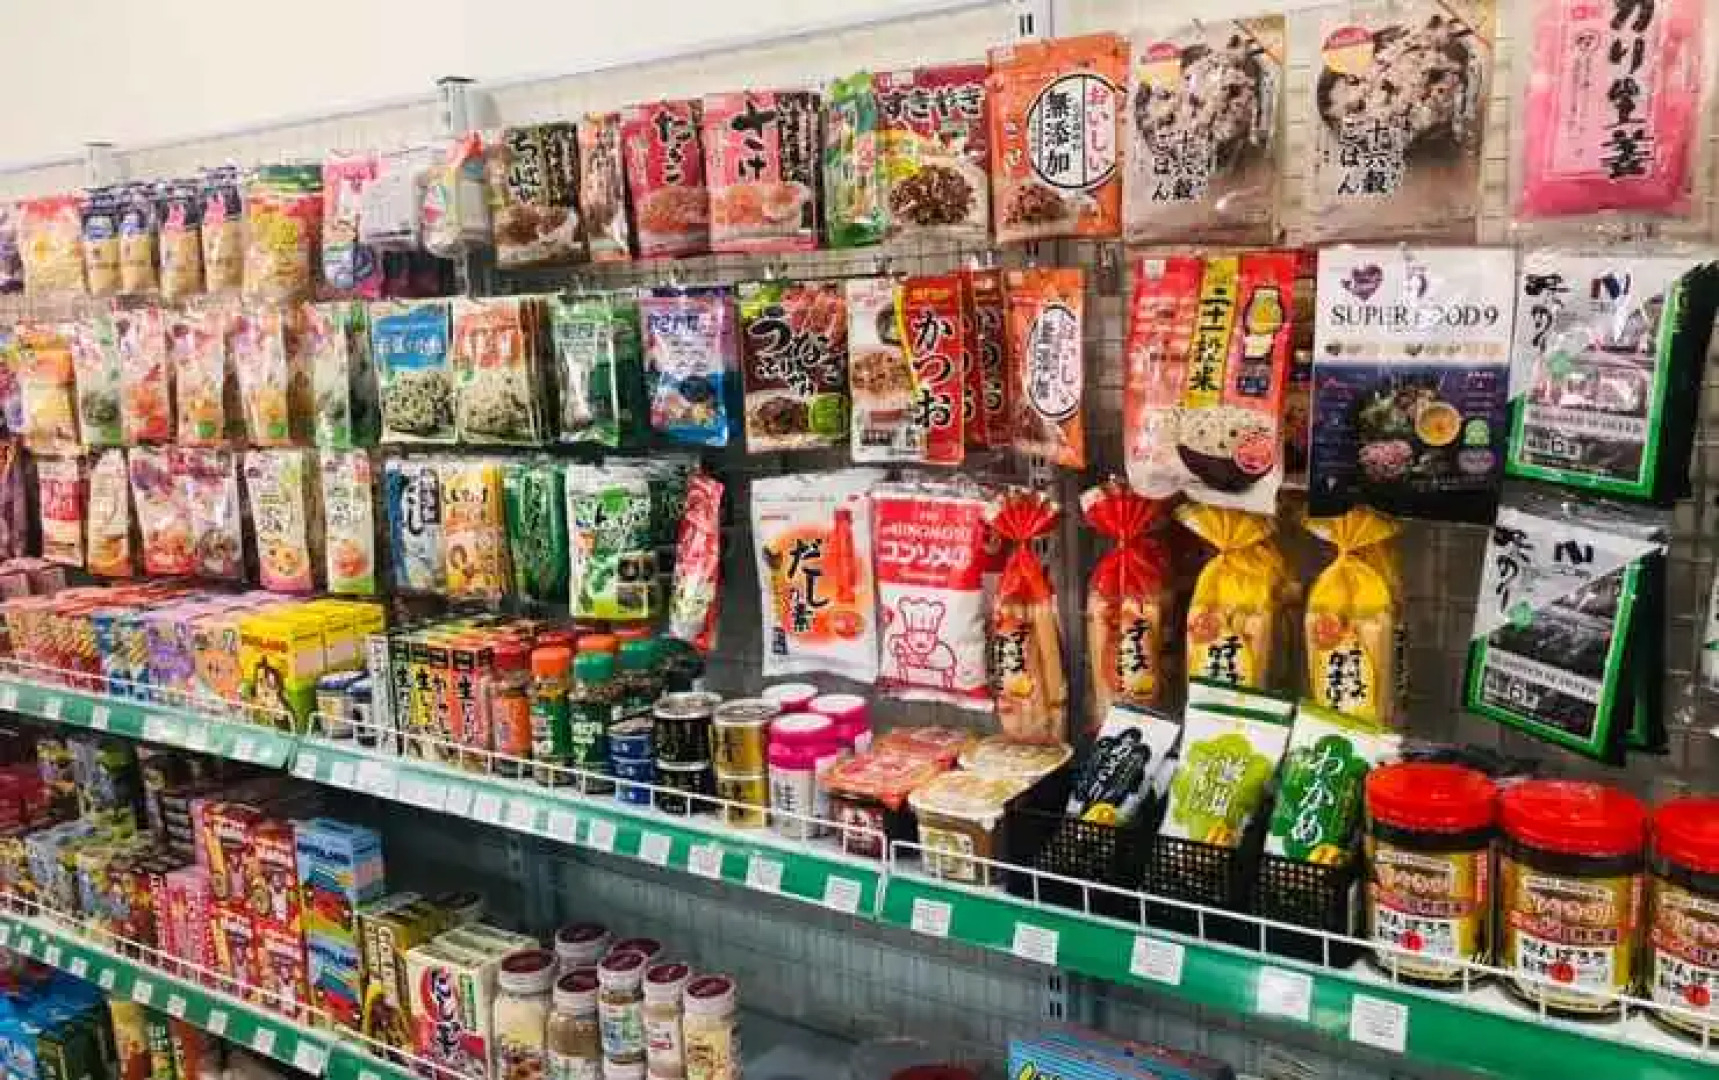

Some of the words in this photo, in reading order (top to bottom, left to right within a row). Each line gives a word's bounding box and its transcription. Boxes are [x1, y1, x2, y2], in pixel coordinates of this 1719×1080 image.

[653, 109, 692, 184] たらこ
[731, 92, 777, 181] さけ
[1045, 90, 1072, 176] 無添加
[1088, 86, 1108, 171] おいしい
[1336, 121, 1361, 196] ごはん
[1331, 305, 1409, 327] SUPER
[1482, 306, 1499, 327] 9
[910, 311, 952, 429] かつお
[1290, 744, 1344, 848] わかめ
